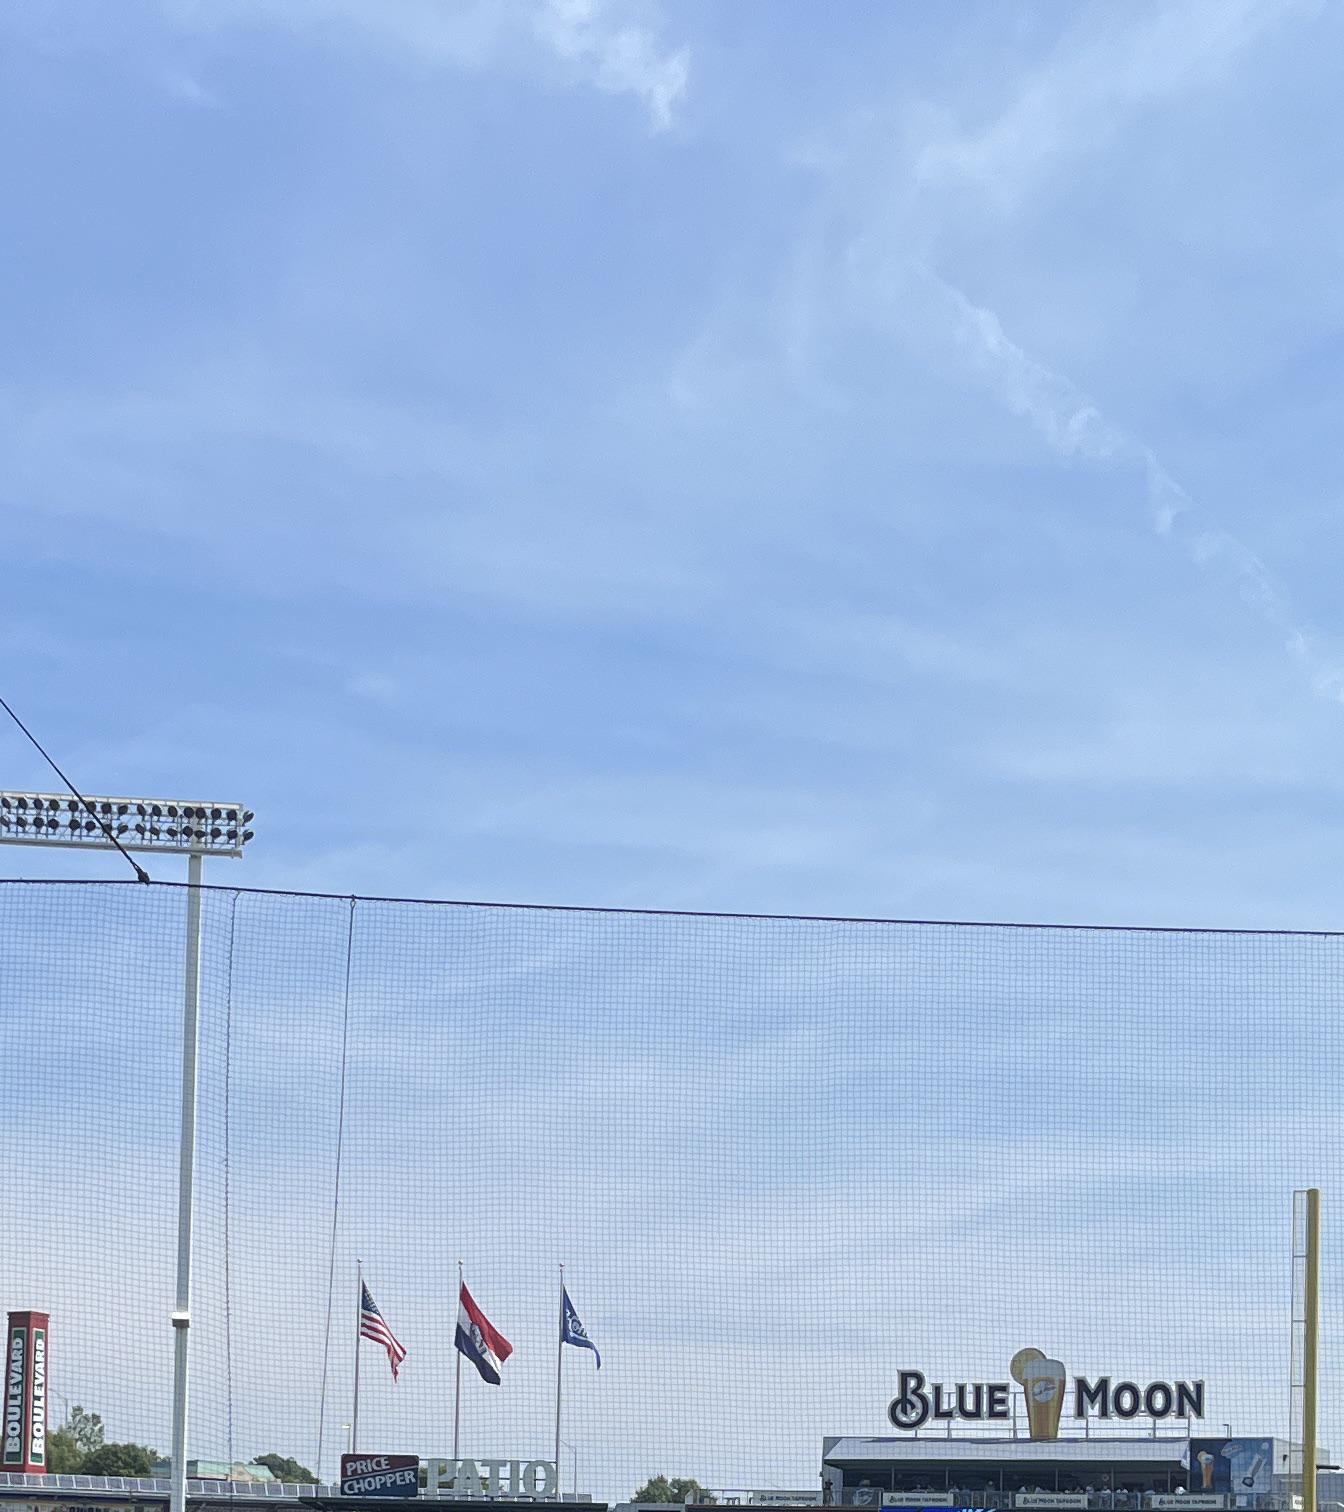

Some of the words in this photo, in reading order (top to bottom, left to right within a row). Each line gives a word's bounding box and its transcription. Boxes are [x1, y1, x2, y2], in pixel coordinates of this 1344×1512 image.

[7, 1337, 24, 1453] BOULEVARD
[32, 1338, 45, 1454] BOULEVARD
[888, 1368, 1010, 1431] BLUE
[1073, 1375, 1205, 1420] MOON
[343, 1470, 417, 1495] CHOPPER
[346, 1456, 390, 1476] PRICE
[426, 1457, 557, 1498] PATIO
